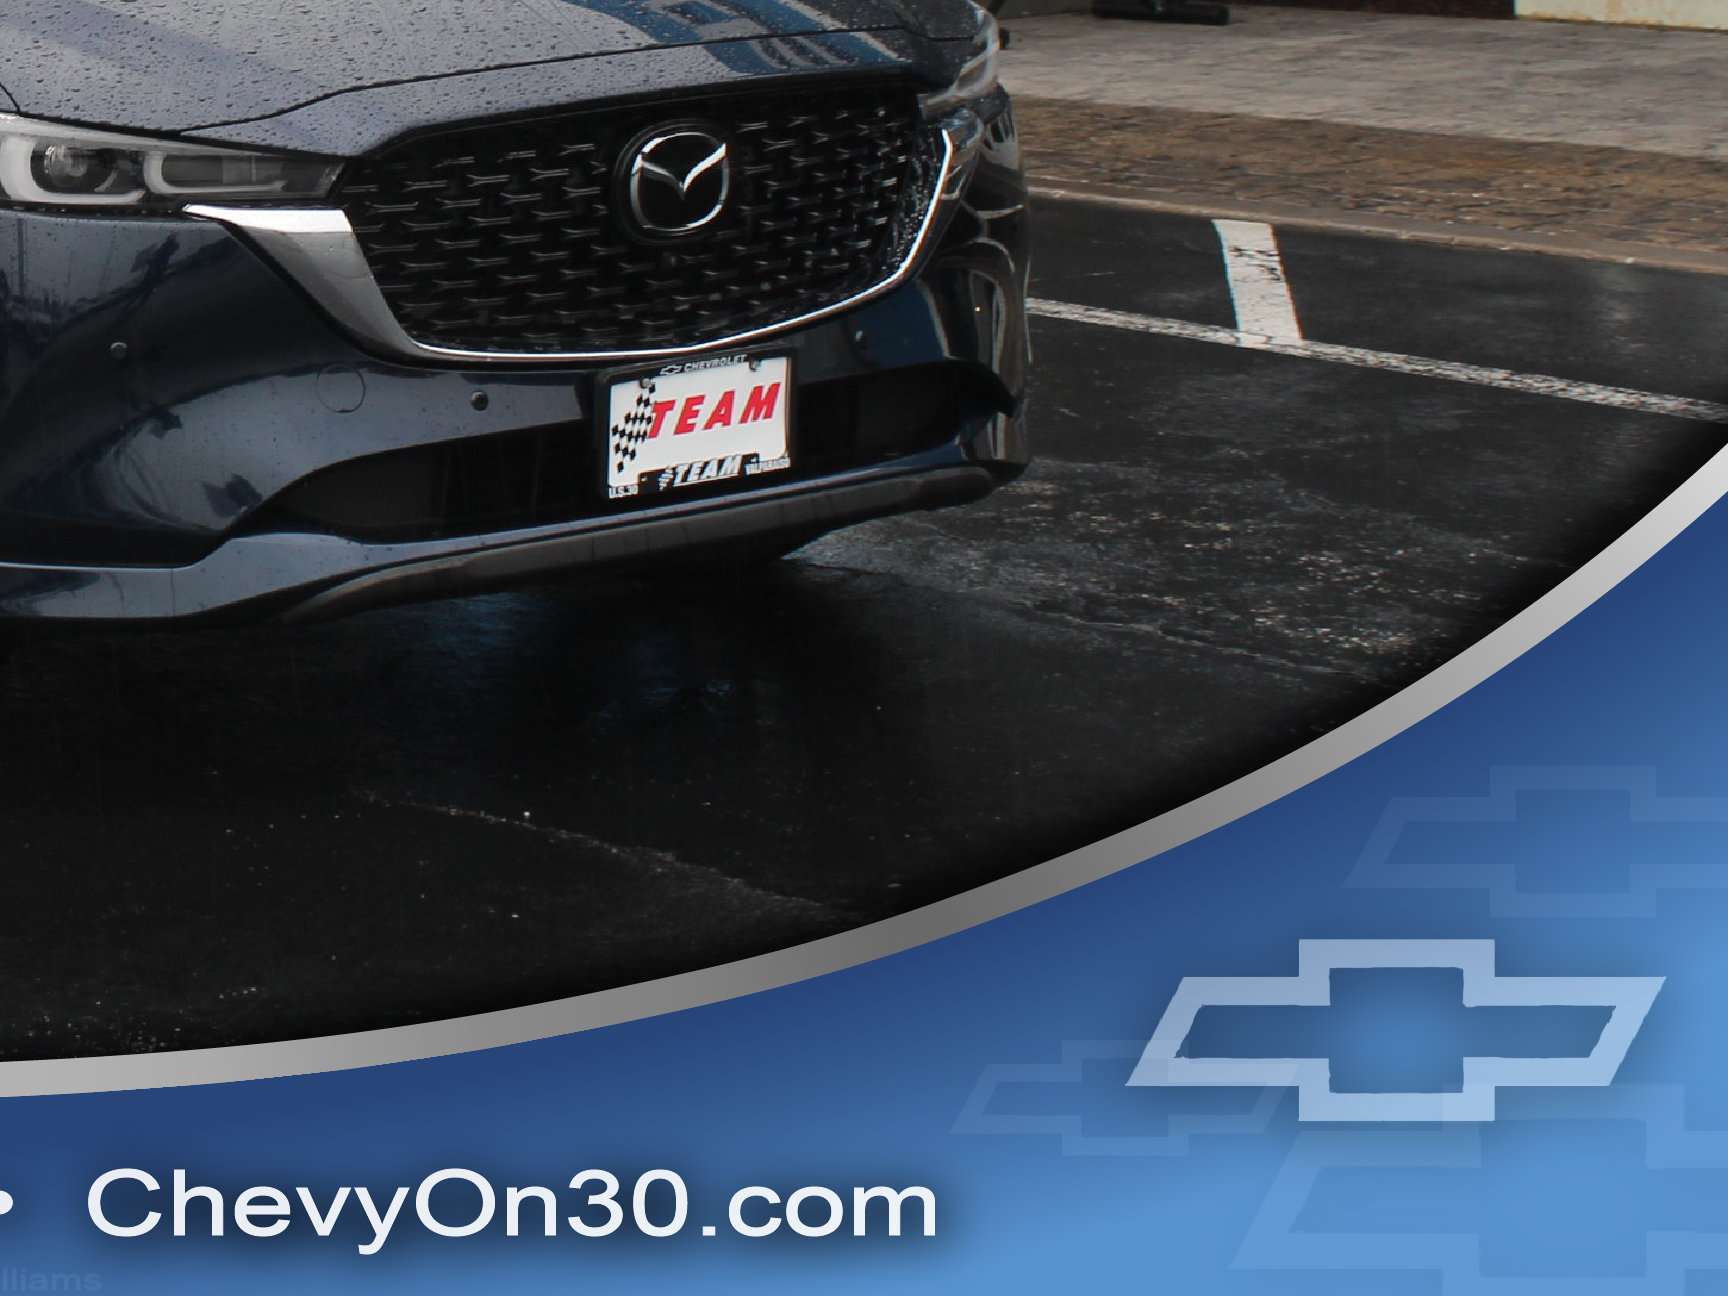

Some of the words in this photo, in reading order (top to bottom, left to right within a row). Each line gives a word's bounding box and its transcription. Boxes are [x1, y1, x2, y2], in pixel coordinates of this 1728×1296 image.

[684, 353, 747, 373] CHEVROLET
[647, 381, 781, 439] TEAM
[672, 455, 744, 487] TEAM
